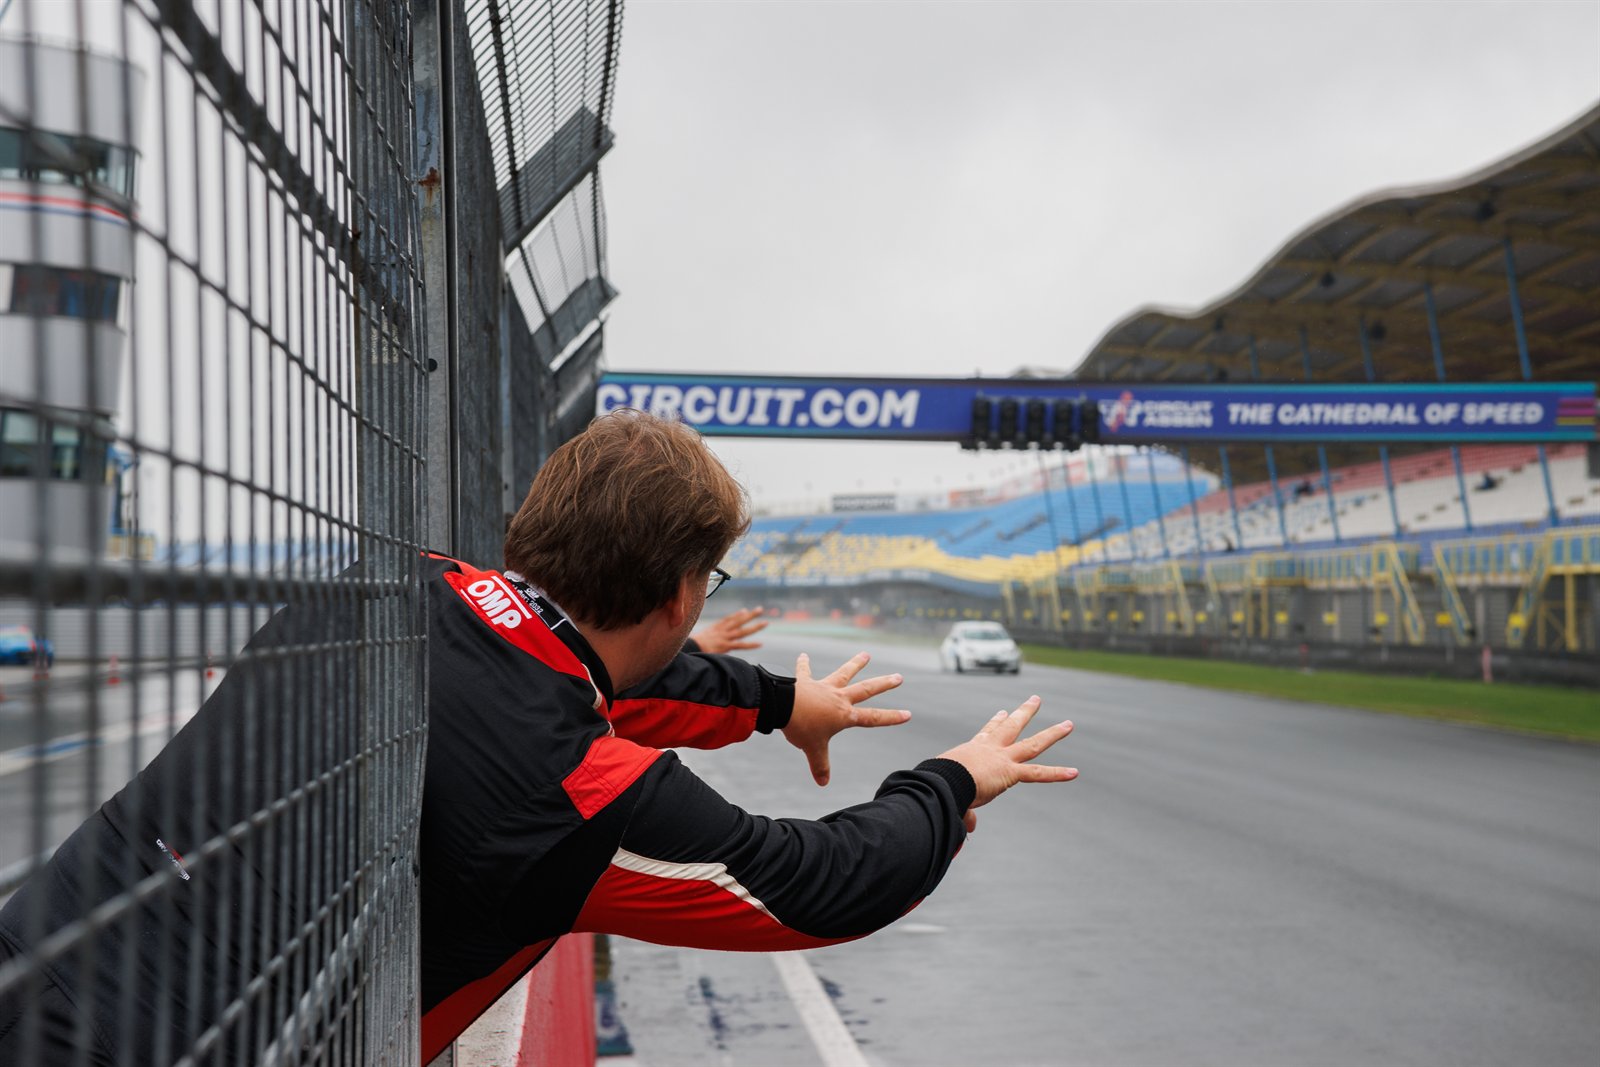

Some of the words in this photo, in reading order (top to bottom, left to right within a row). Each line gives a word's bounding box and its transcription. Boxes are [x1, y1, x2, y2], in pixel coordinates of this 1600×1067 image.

[1142, 400, 1213, 412] CIRCUIT
[1228, 403, 1274, 425] THE
[1277, 403, 1419, 425] CATHEDRAL
[1424, 403, 1459, 425] OF
[1462, 403, 1545, 425] SPEED
[1142, 412, 1213, 428] ASSEN
[467, 579, 522, 629] OMP
